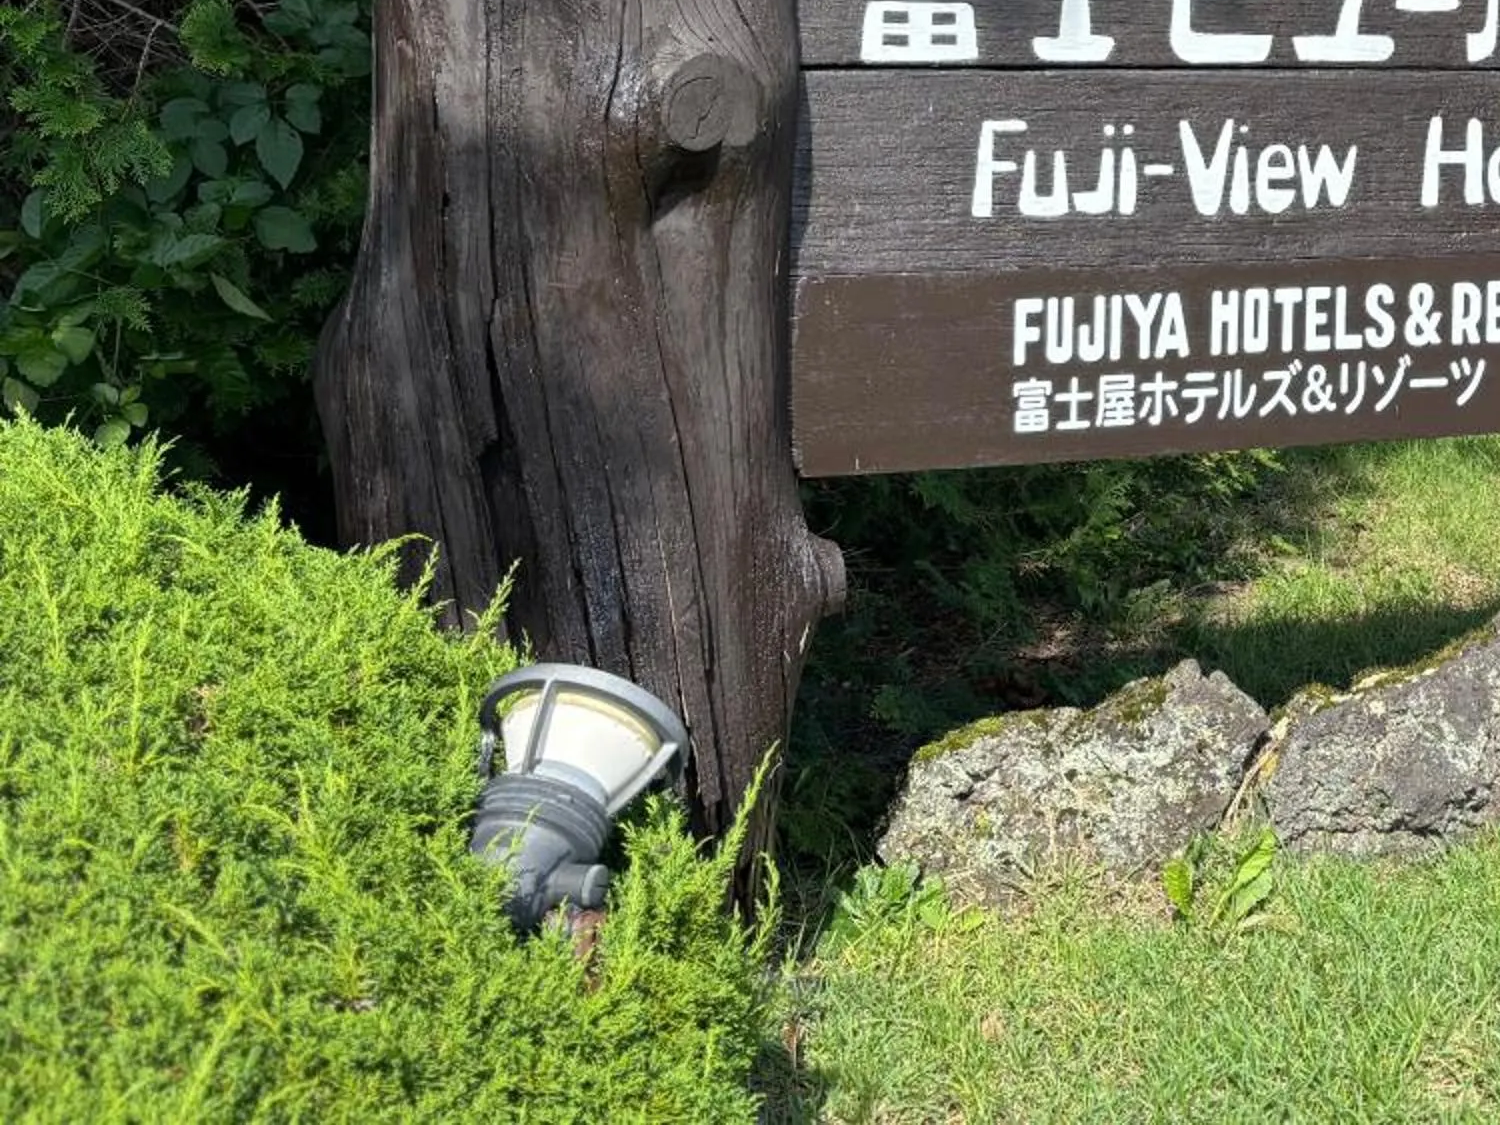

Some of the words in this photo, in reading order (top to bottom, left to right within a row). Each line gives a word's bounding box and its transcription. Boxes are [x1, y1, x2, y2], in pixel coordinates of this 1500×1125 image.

[969, 117, 1358, 222] Fuji-View
[1012, 290, 1191, 367] FUJIYA
[1011, 353, 1488, 434] 富士屋ホテルズ&リゾーツ
